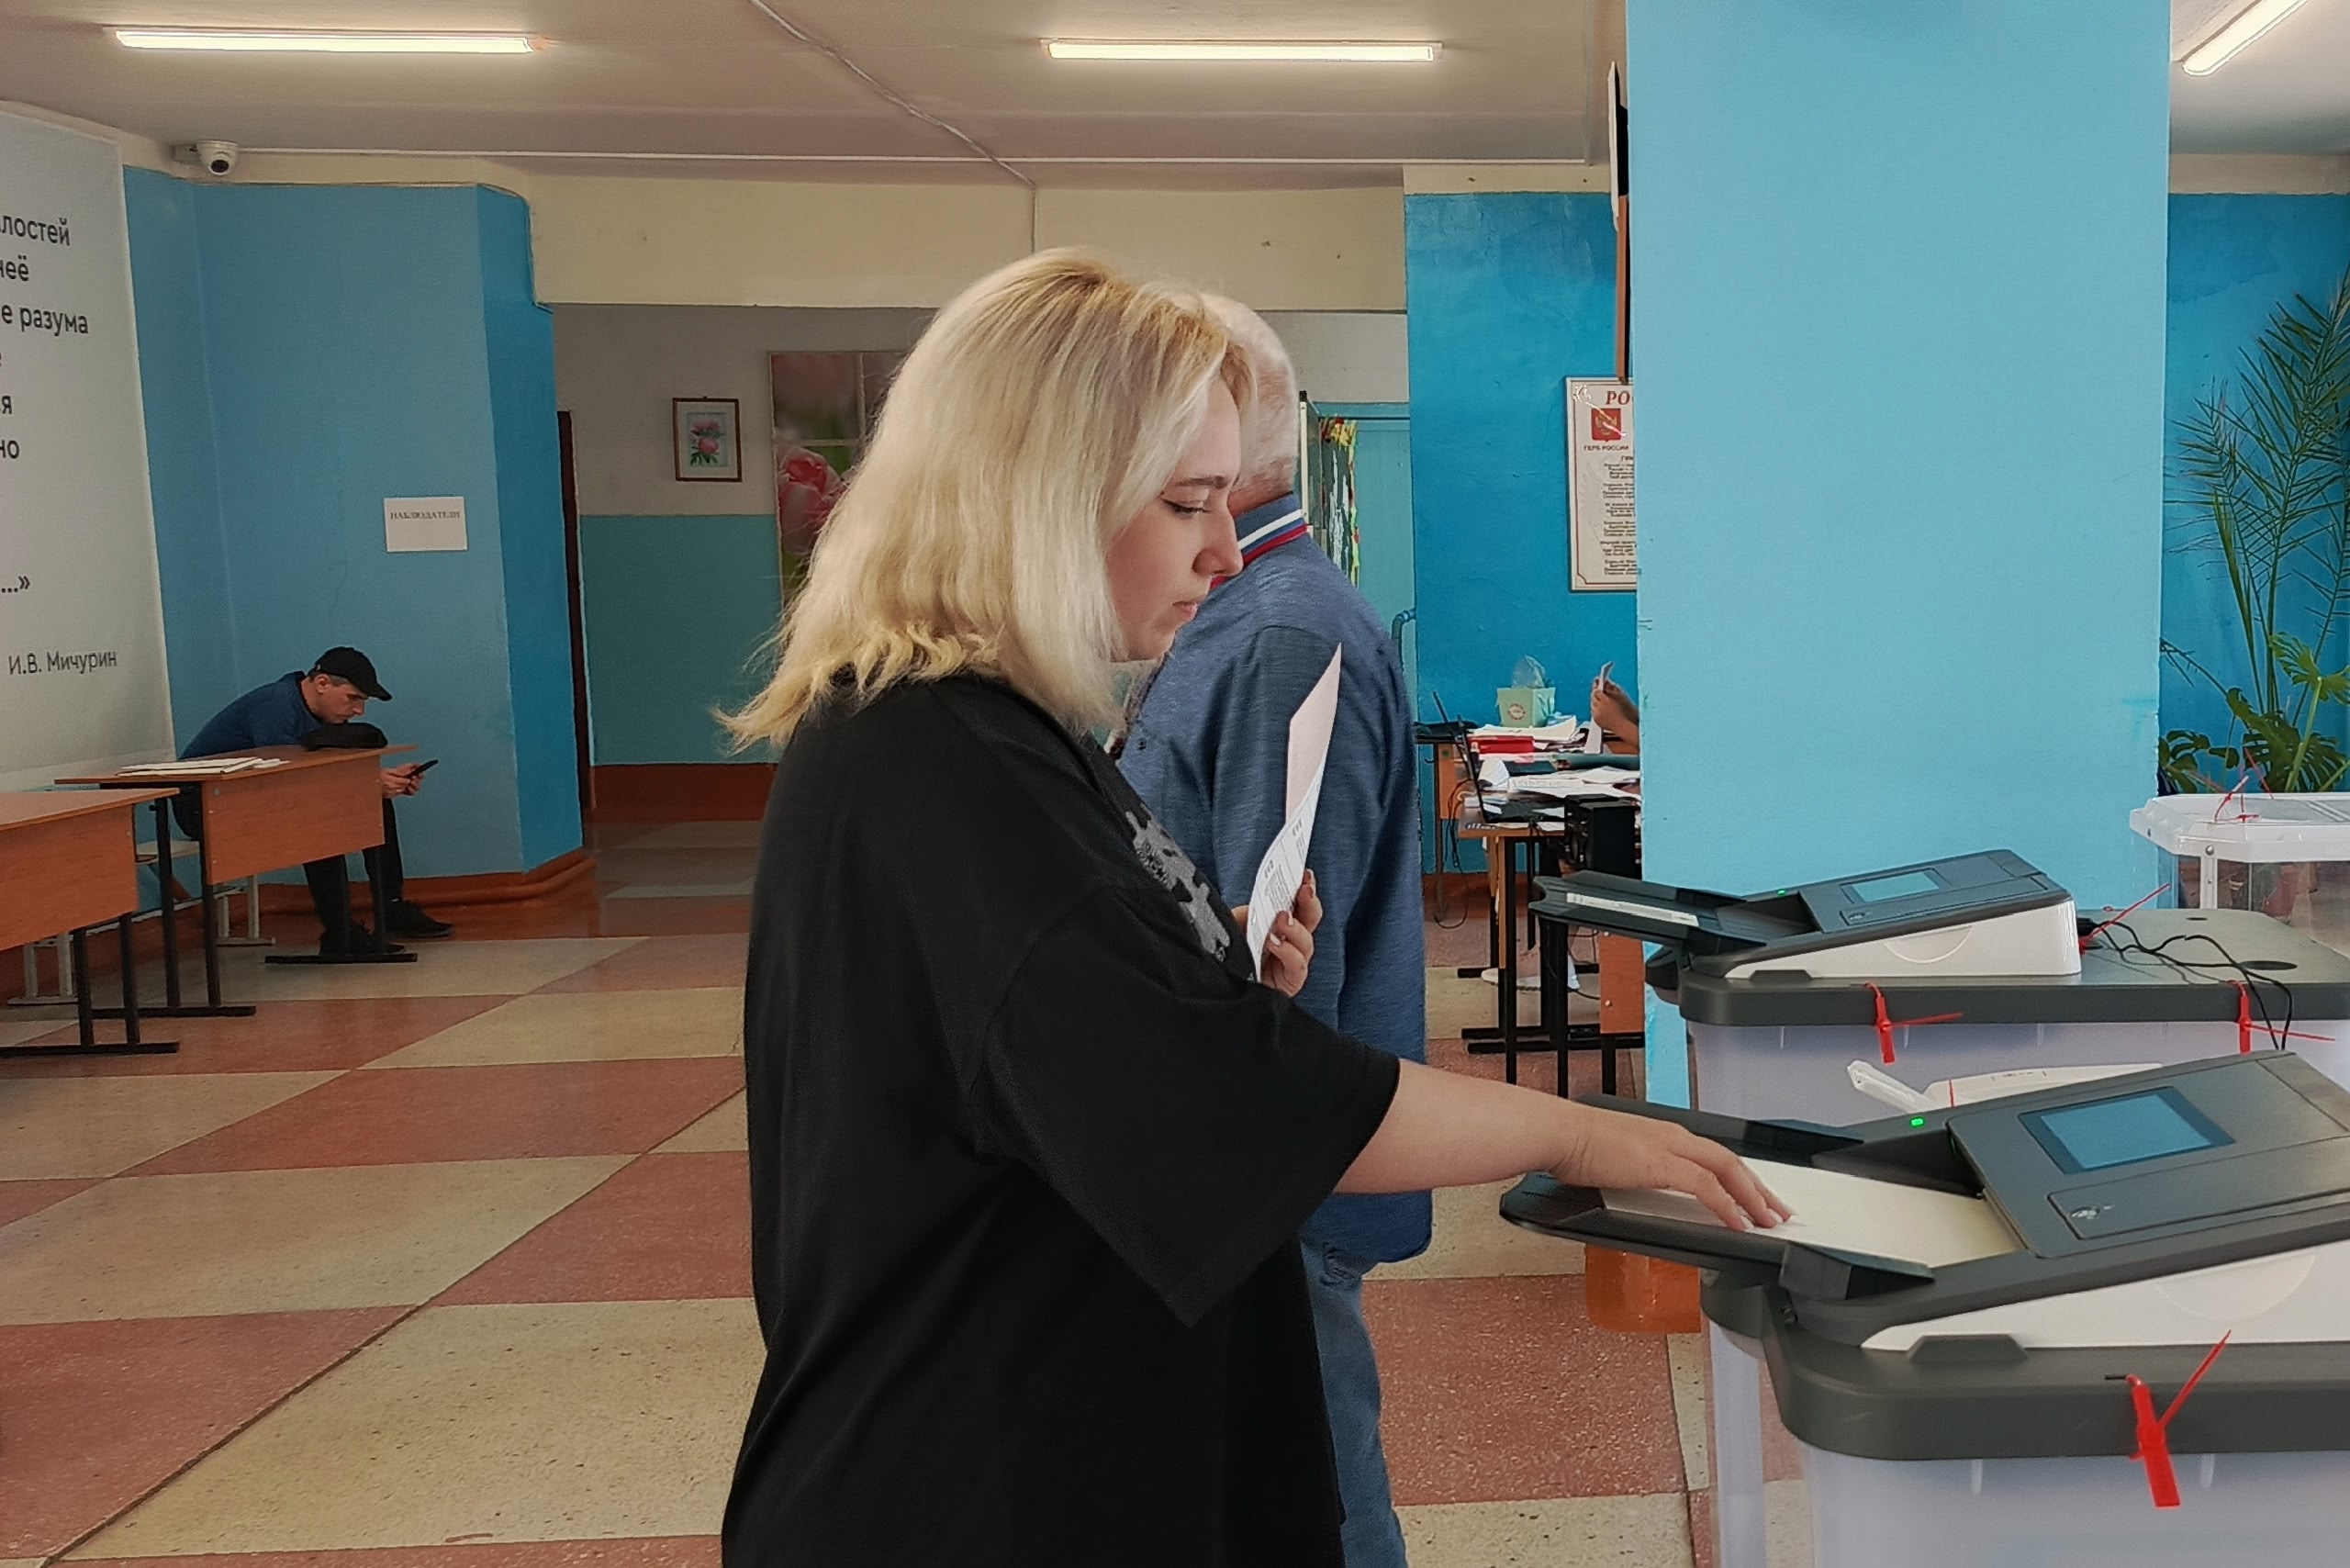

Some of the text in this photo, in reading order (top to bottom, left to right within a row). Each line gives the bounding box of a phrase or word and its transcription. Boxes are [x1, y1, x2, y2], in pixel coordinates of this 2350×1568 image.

[0, 215, 71, 246] лостей
[19, 308, 89, 337] разума
[8, 651, 118, 675] И.В. Мичурин
